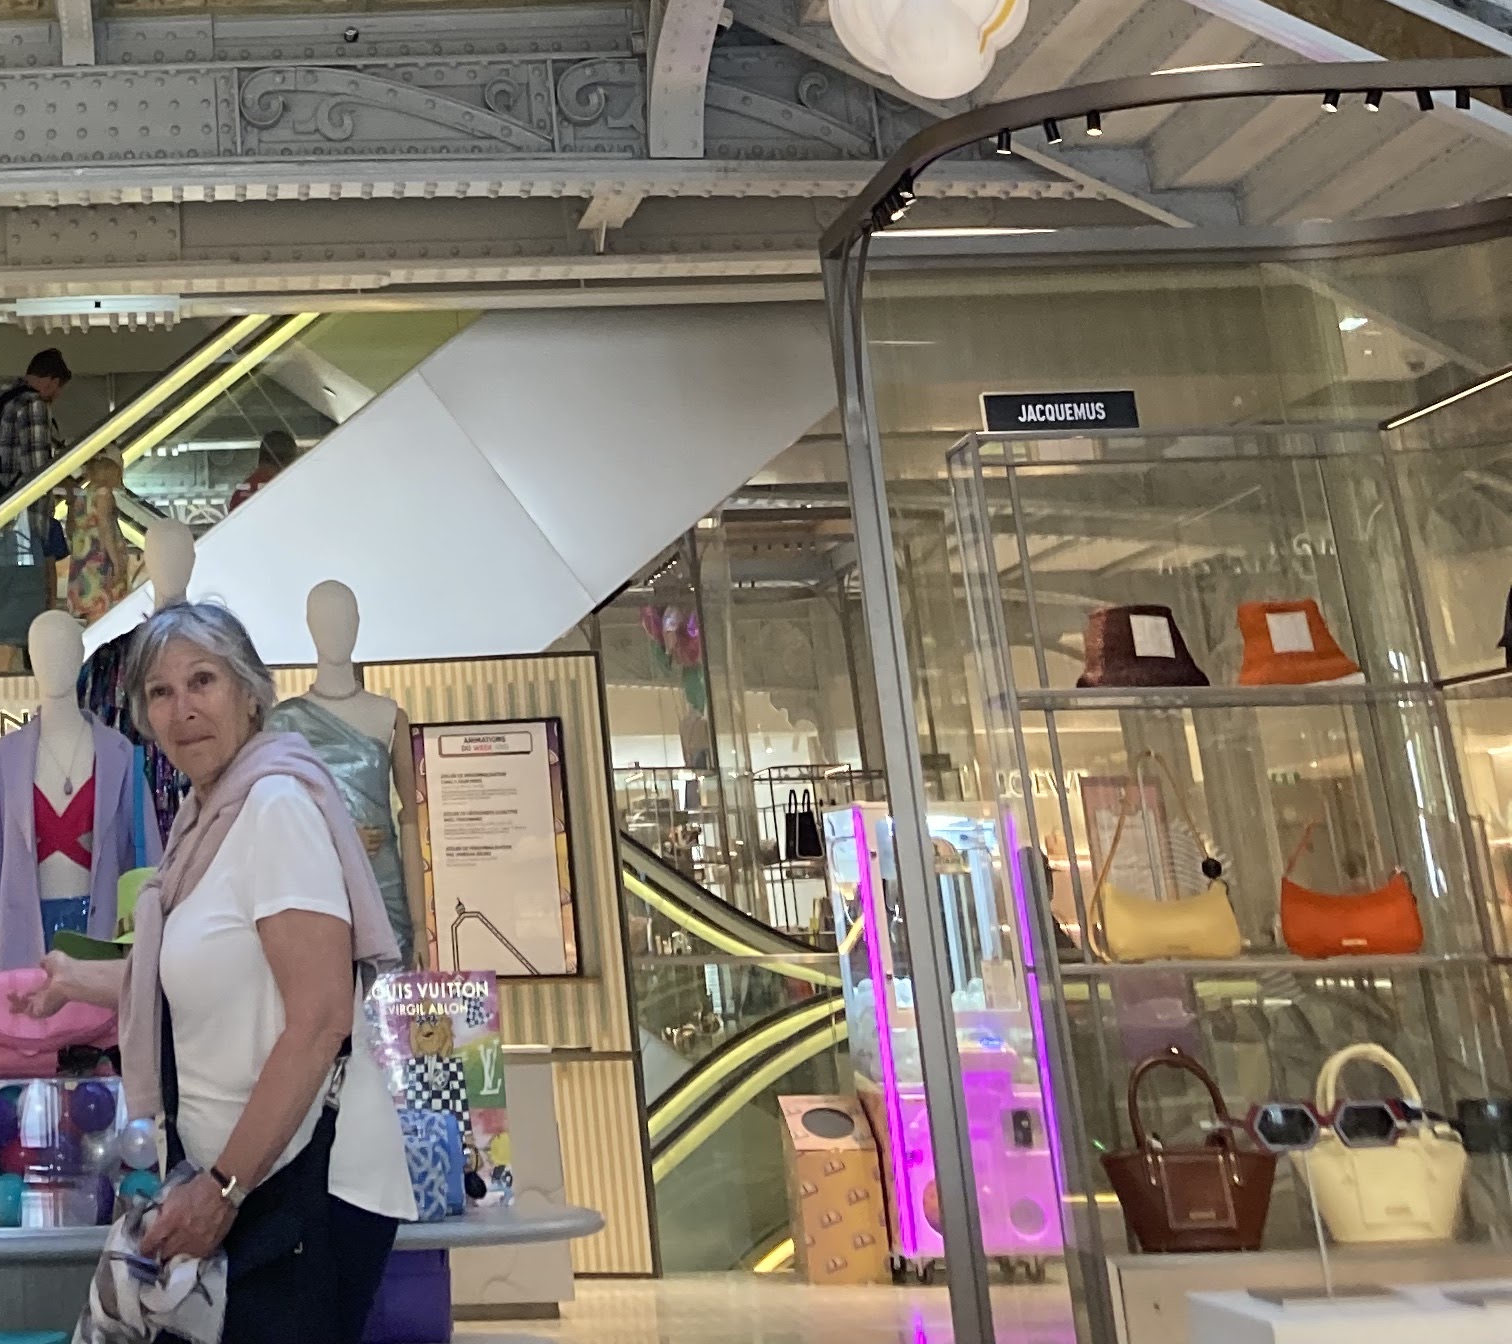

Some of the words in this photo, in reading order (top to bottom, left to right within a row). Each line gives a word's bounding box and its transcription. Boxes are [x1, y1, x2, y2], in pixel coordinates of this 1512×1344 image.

[1017, 401, 1107, 423] JACQUEMUS
[365, 983, 414, 1003] OUIS
[416, 981, 489, 999] VUITTON
[388, 1003, 427, 1016] VIRGIL
[428, 1002, 469, 1015] ABLOH
